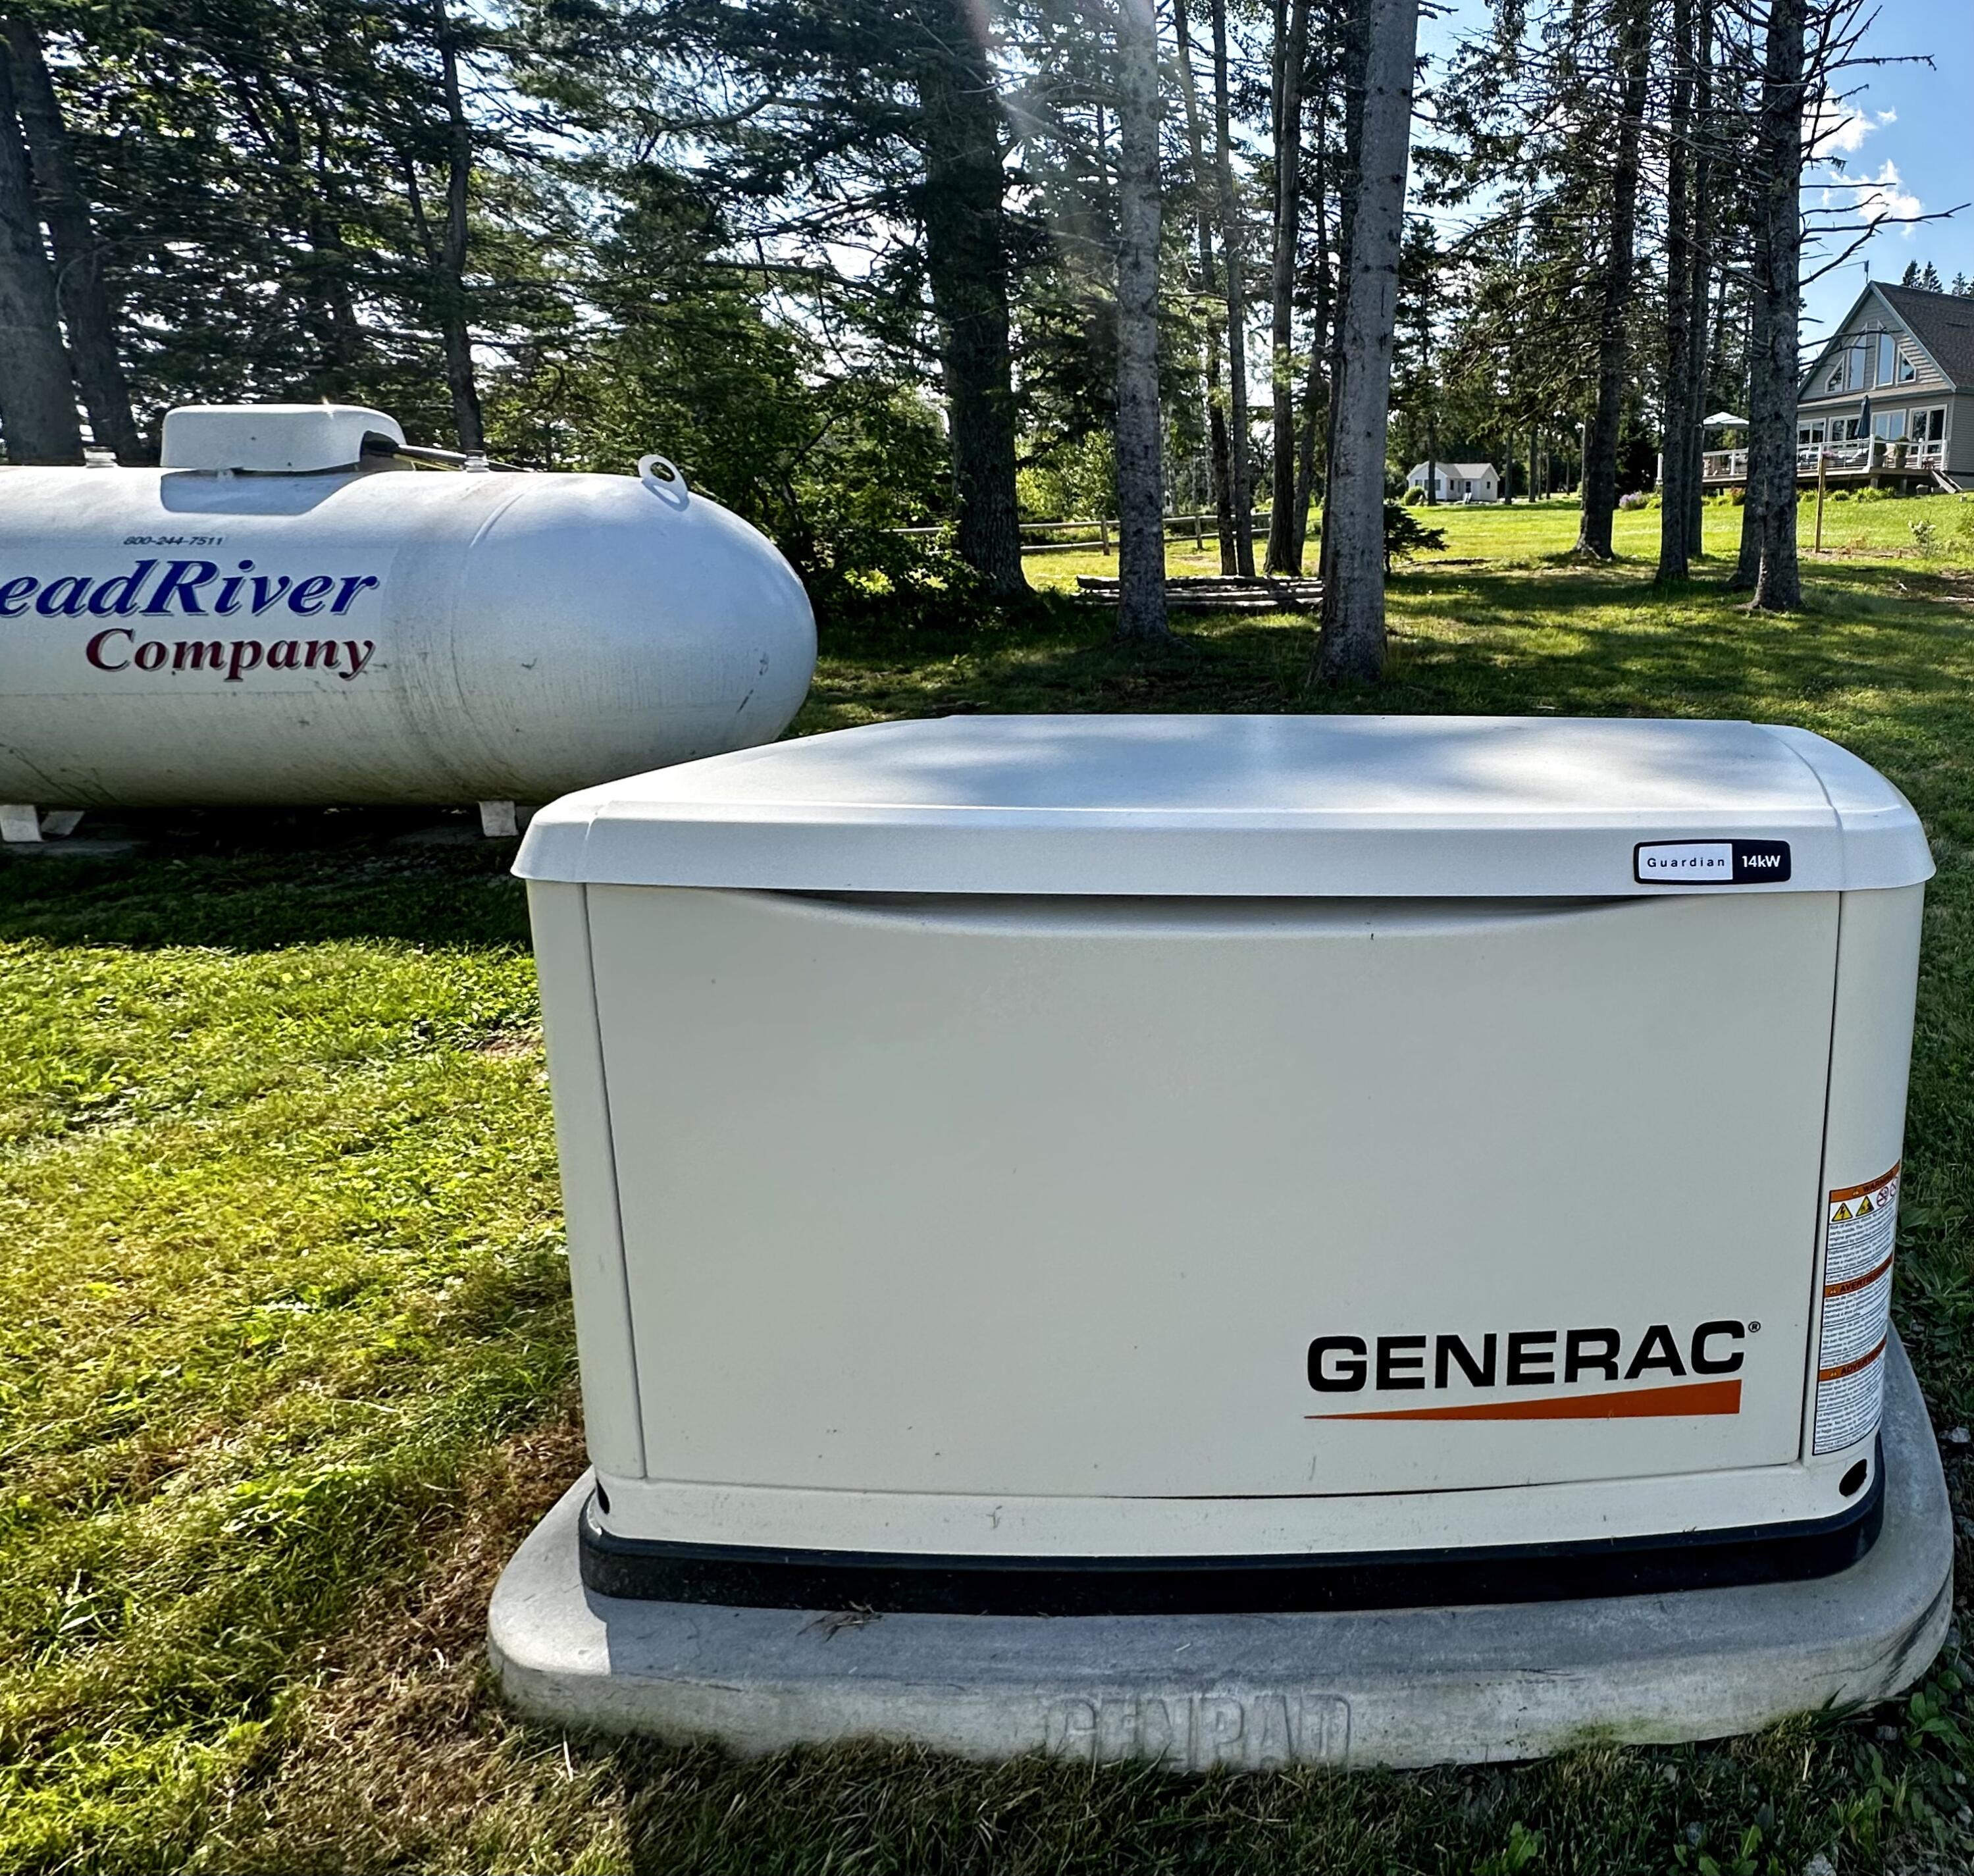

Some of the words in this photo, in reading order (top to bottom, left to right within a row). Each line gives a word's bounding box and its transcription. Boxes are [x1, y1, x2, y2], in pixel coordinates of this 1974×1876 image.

[124, 536, 223, 545] 800-244-7511
[86, 628, 376, 682] Company
[1648, 858, 1725, 868] Guardian
[1742, 855, 1781, 868] 14kW
